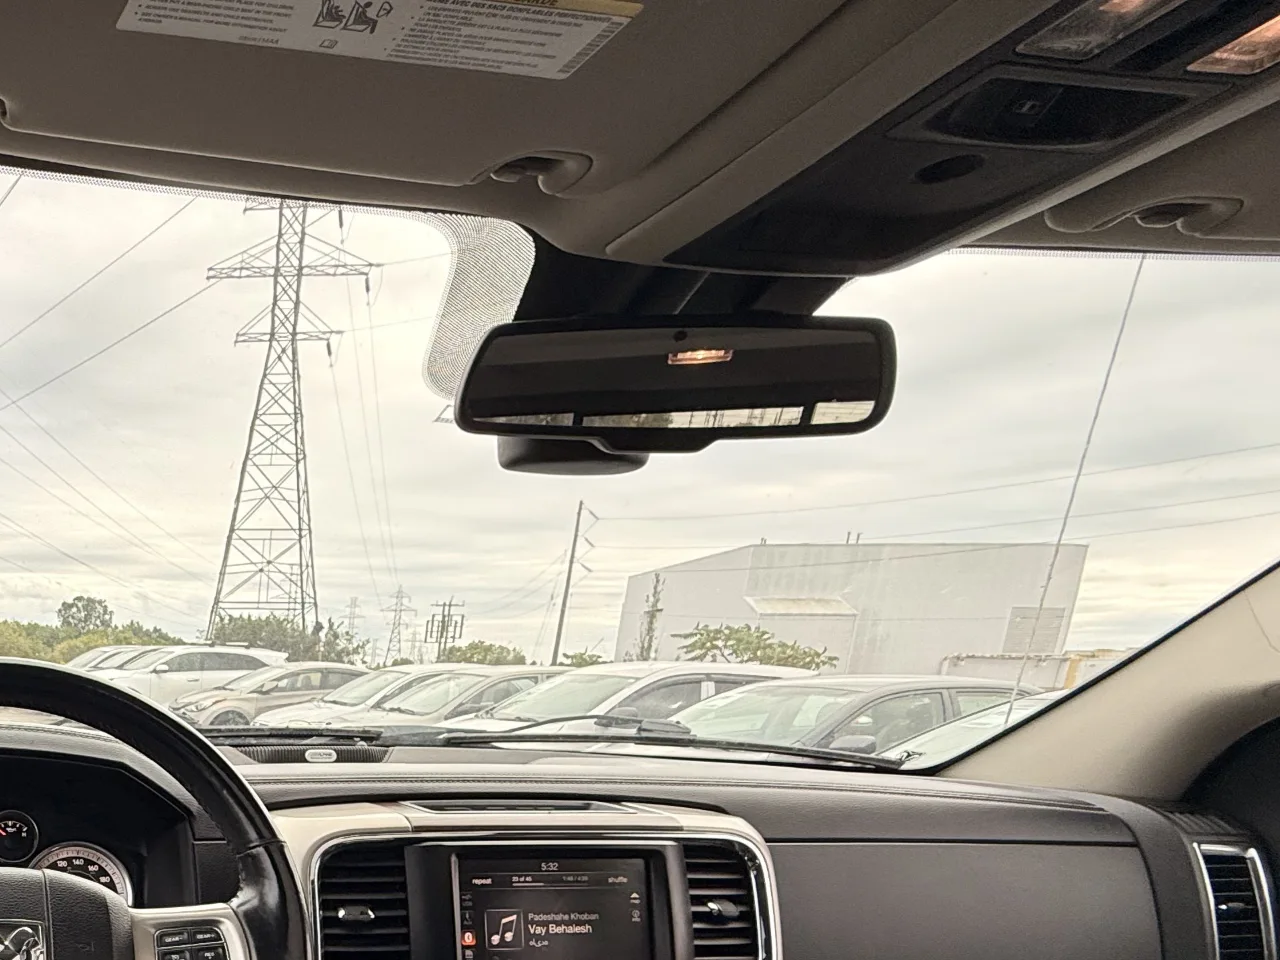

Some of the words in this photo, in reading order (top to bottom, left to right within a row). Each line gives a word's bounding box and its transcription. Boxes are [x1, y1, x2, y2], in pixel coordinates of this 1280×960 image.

[72, 858, 85, 866] 140
[87, 864, 99, 872] 160
[540, 862, 559, 871] 5:32
[472, 877, 492, 886] repeat
[528, 923, 547, 936] Vay
[548, 923, 593, 934] Behalesh
